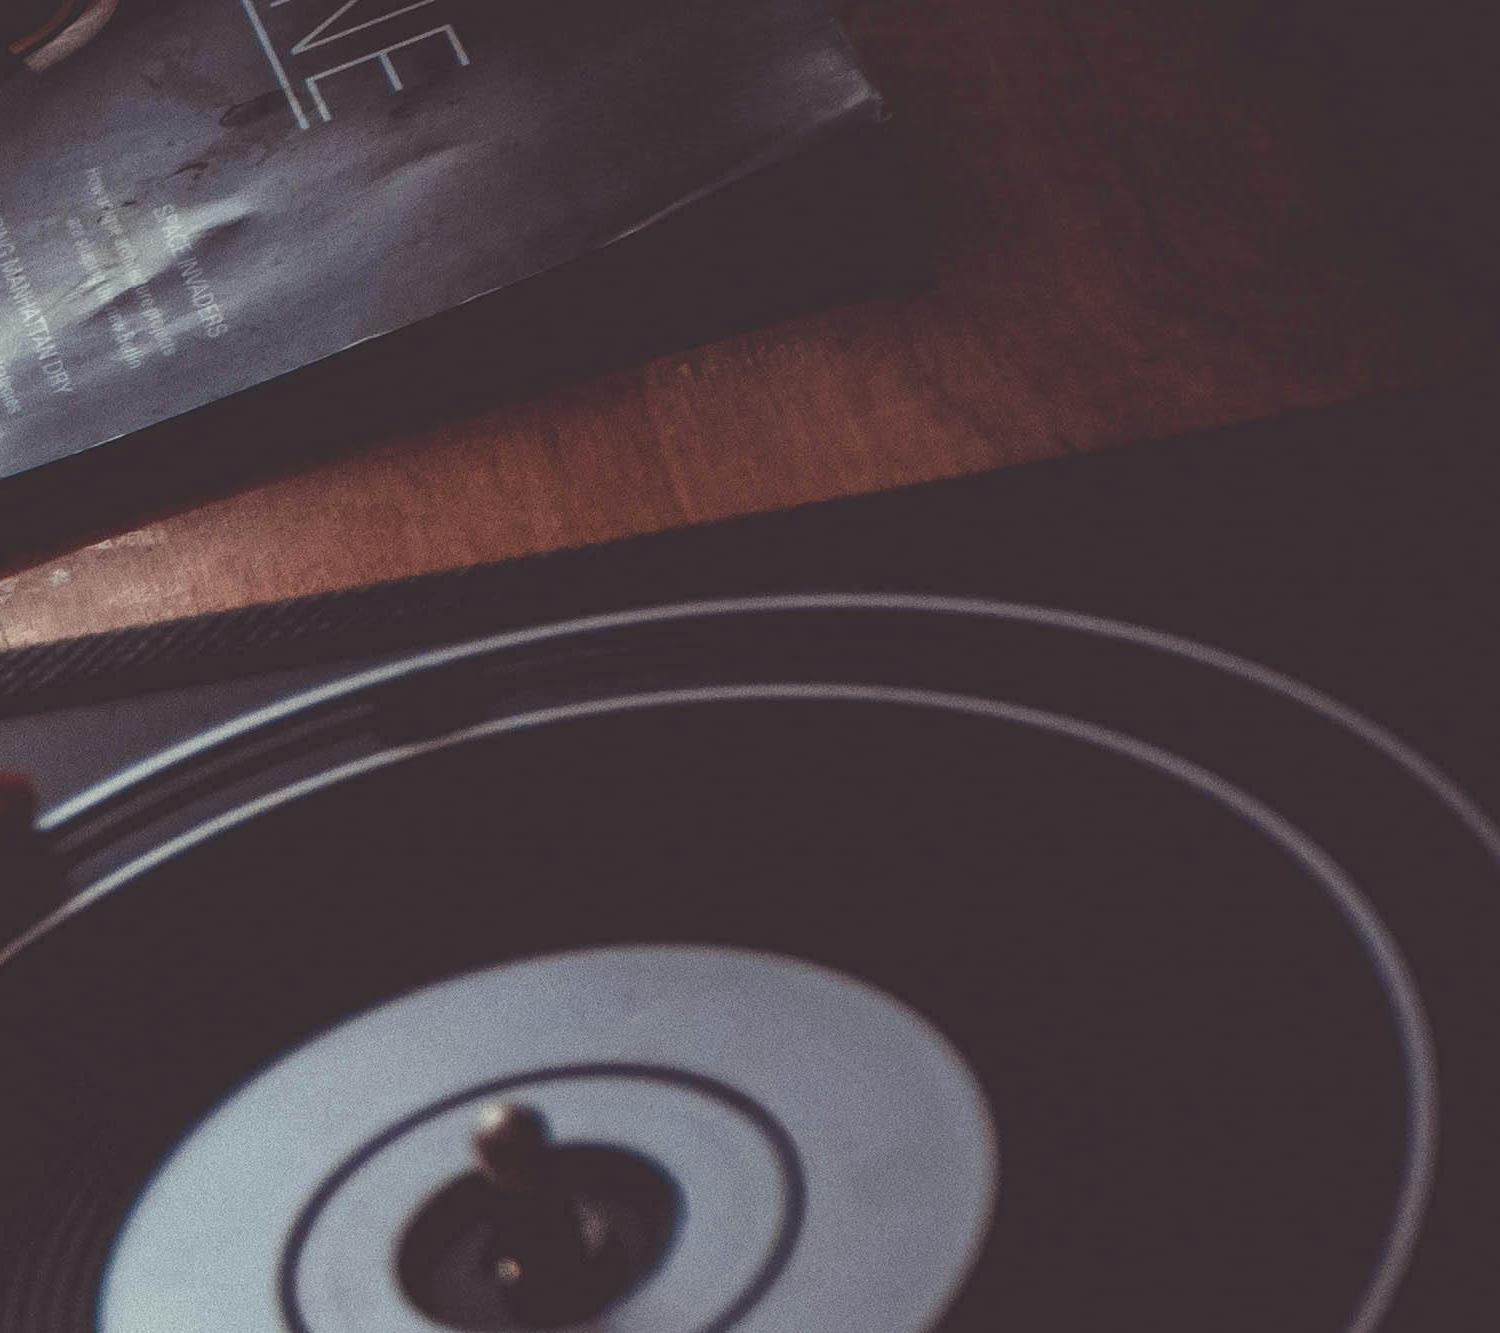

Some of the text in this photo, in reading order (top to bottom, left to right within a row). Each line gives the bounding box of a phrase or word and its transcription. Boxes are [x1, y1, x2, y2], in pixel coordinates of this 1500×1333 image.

[270, 0, 471, 122] NE
[0, 258, 57, 360] MANHATTAN
[44, 359, 73, 396] DRY
[154, 204, 228, 339] SPACE INVADERS
